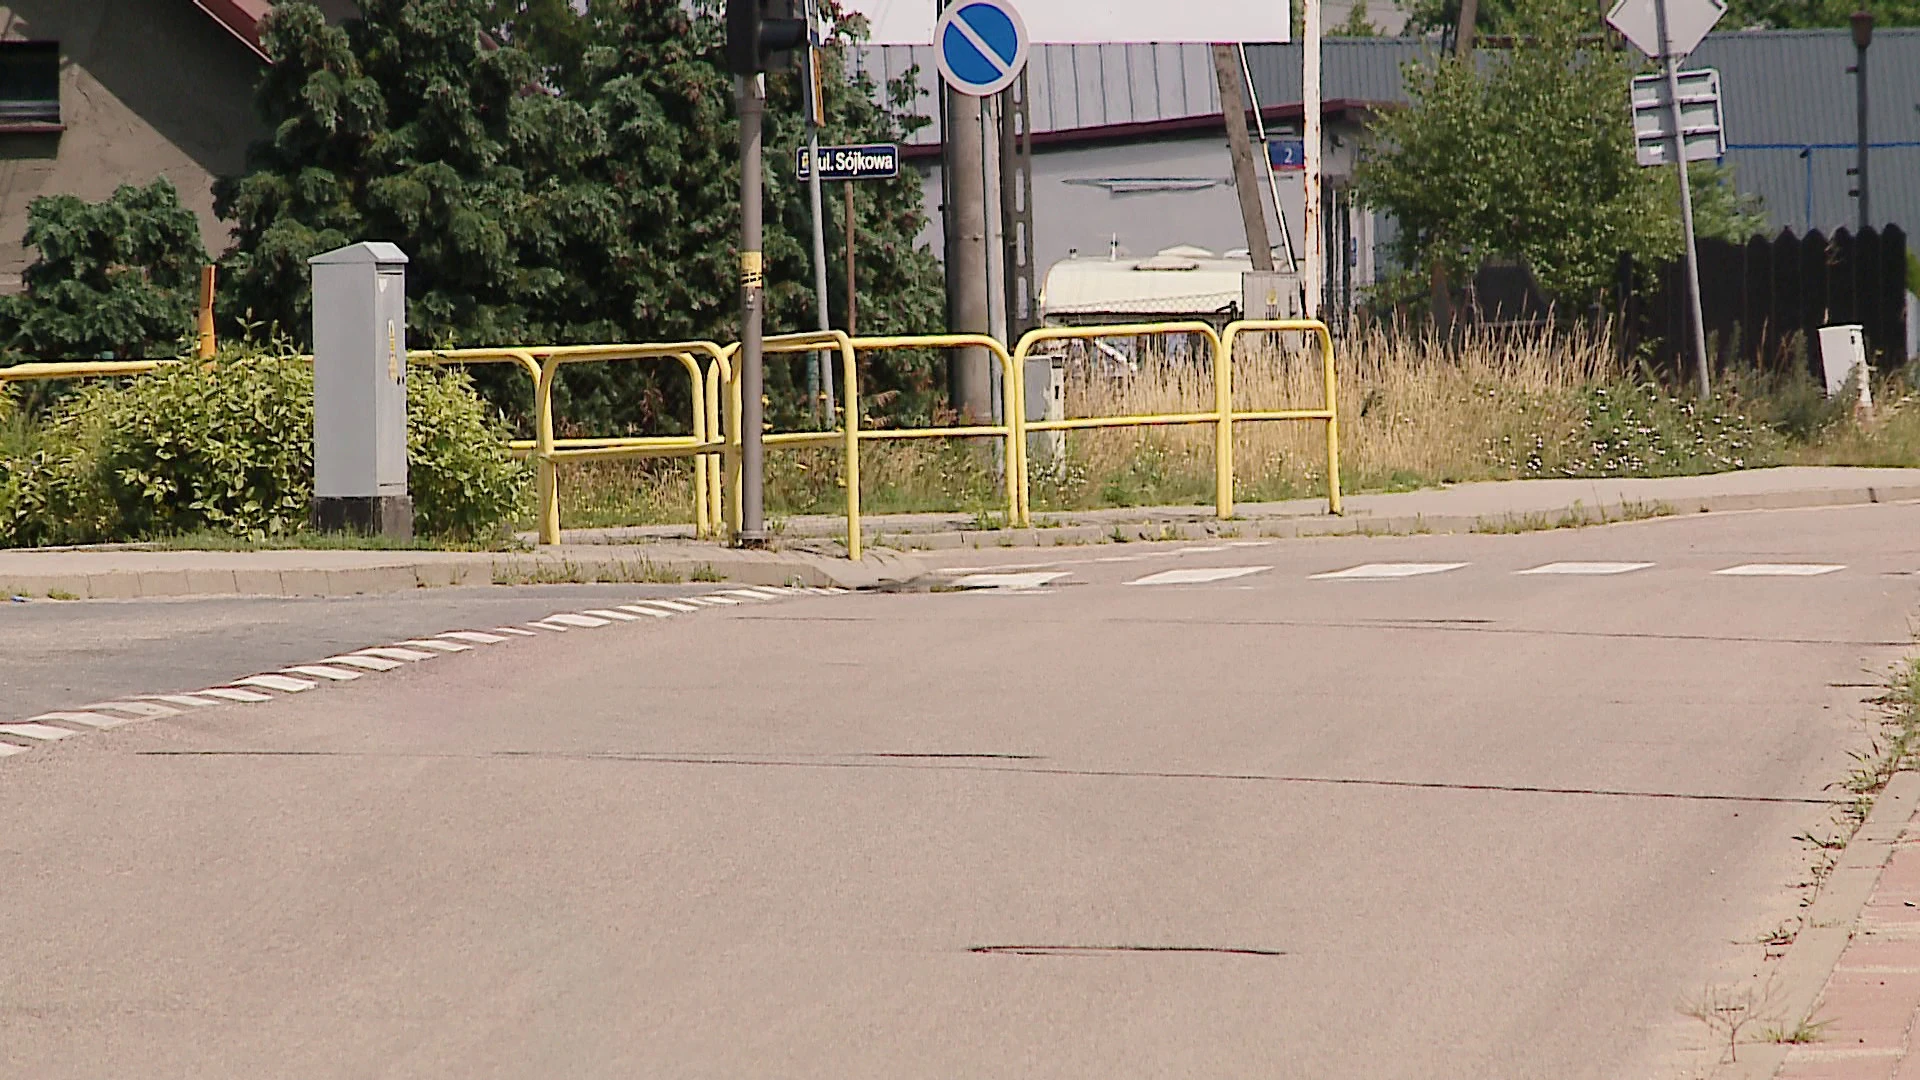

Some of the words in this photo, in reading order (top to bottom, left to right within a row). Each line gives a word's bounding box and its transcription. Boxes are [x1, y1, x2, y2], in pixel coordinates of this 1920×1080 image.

[818, 151, 834, 171] ul.
[836, 150, 893, 175] Sójkowa
[1284, 147, 1293, 164] 2
